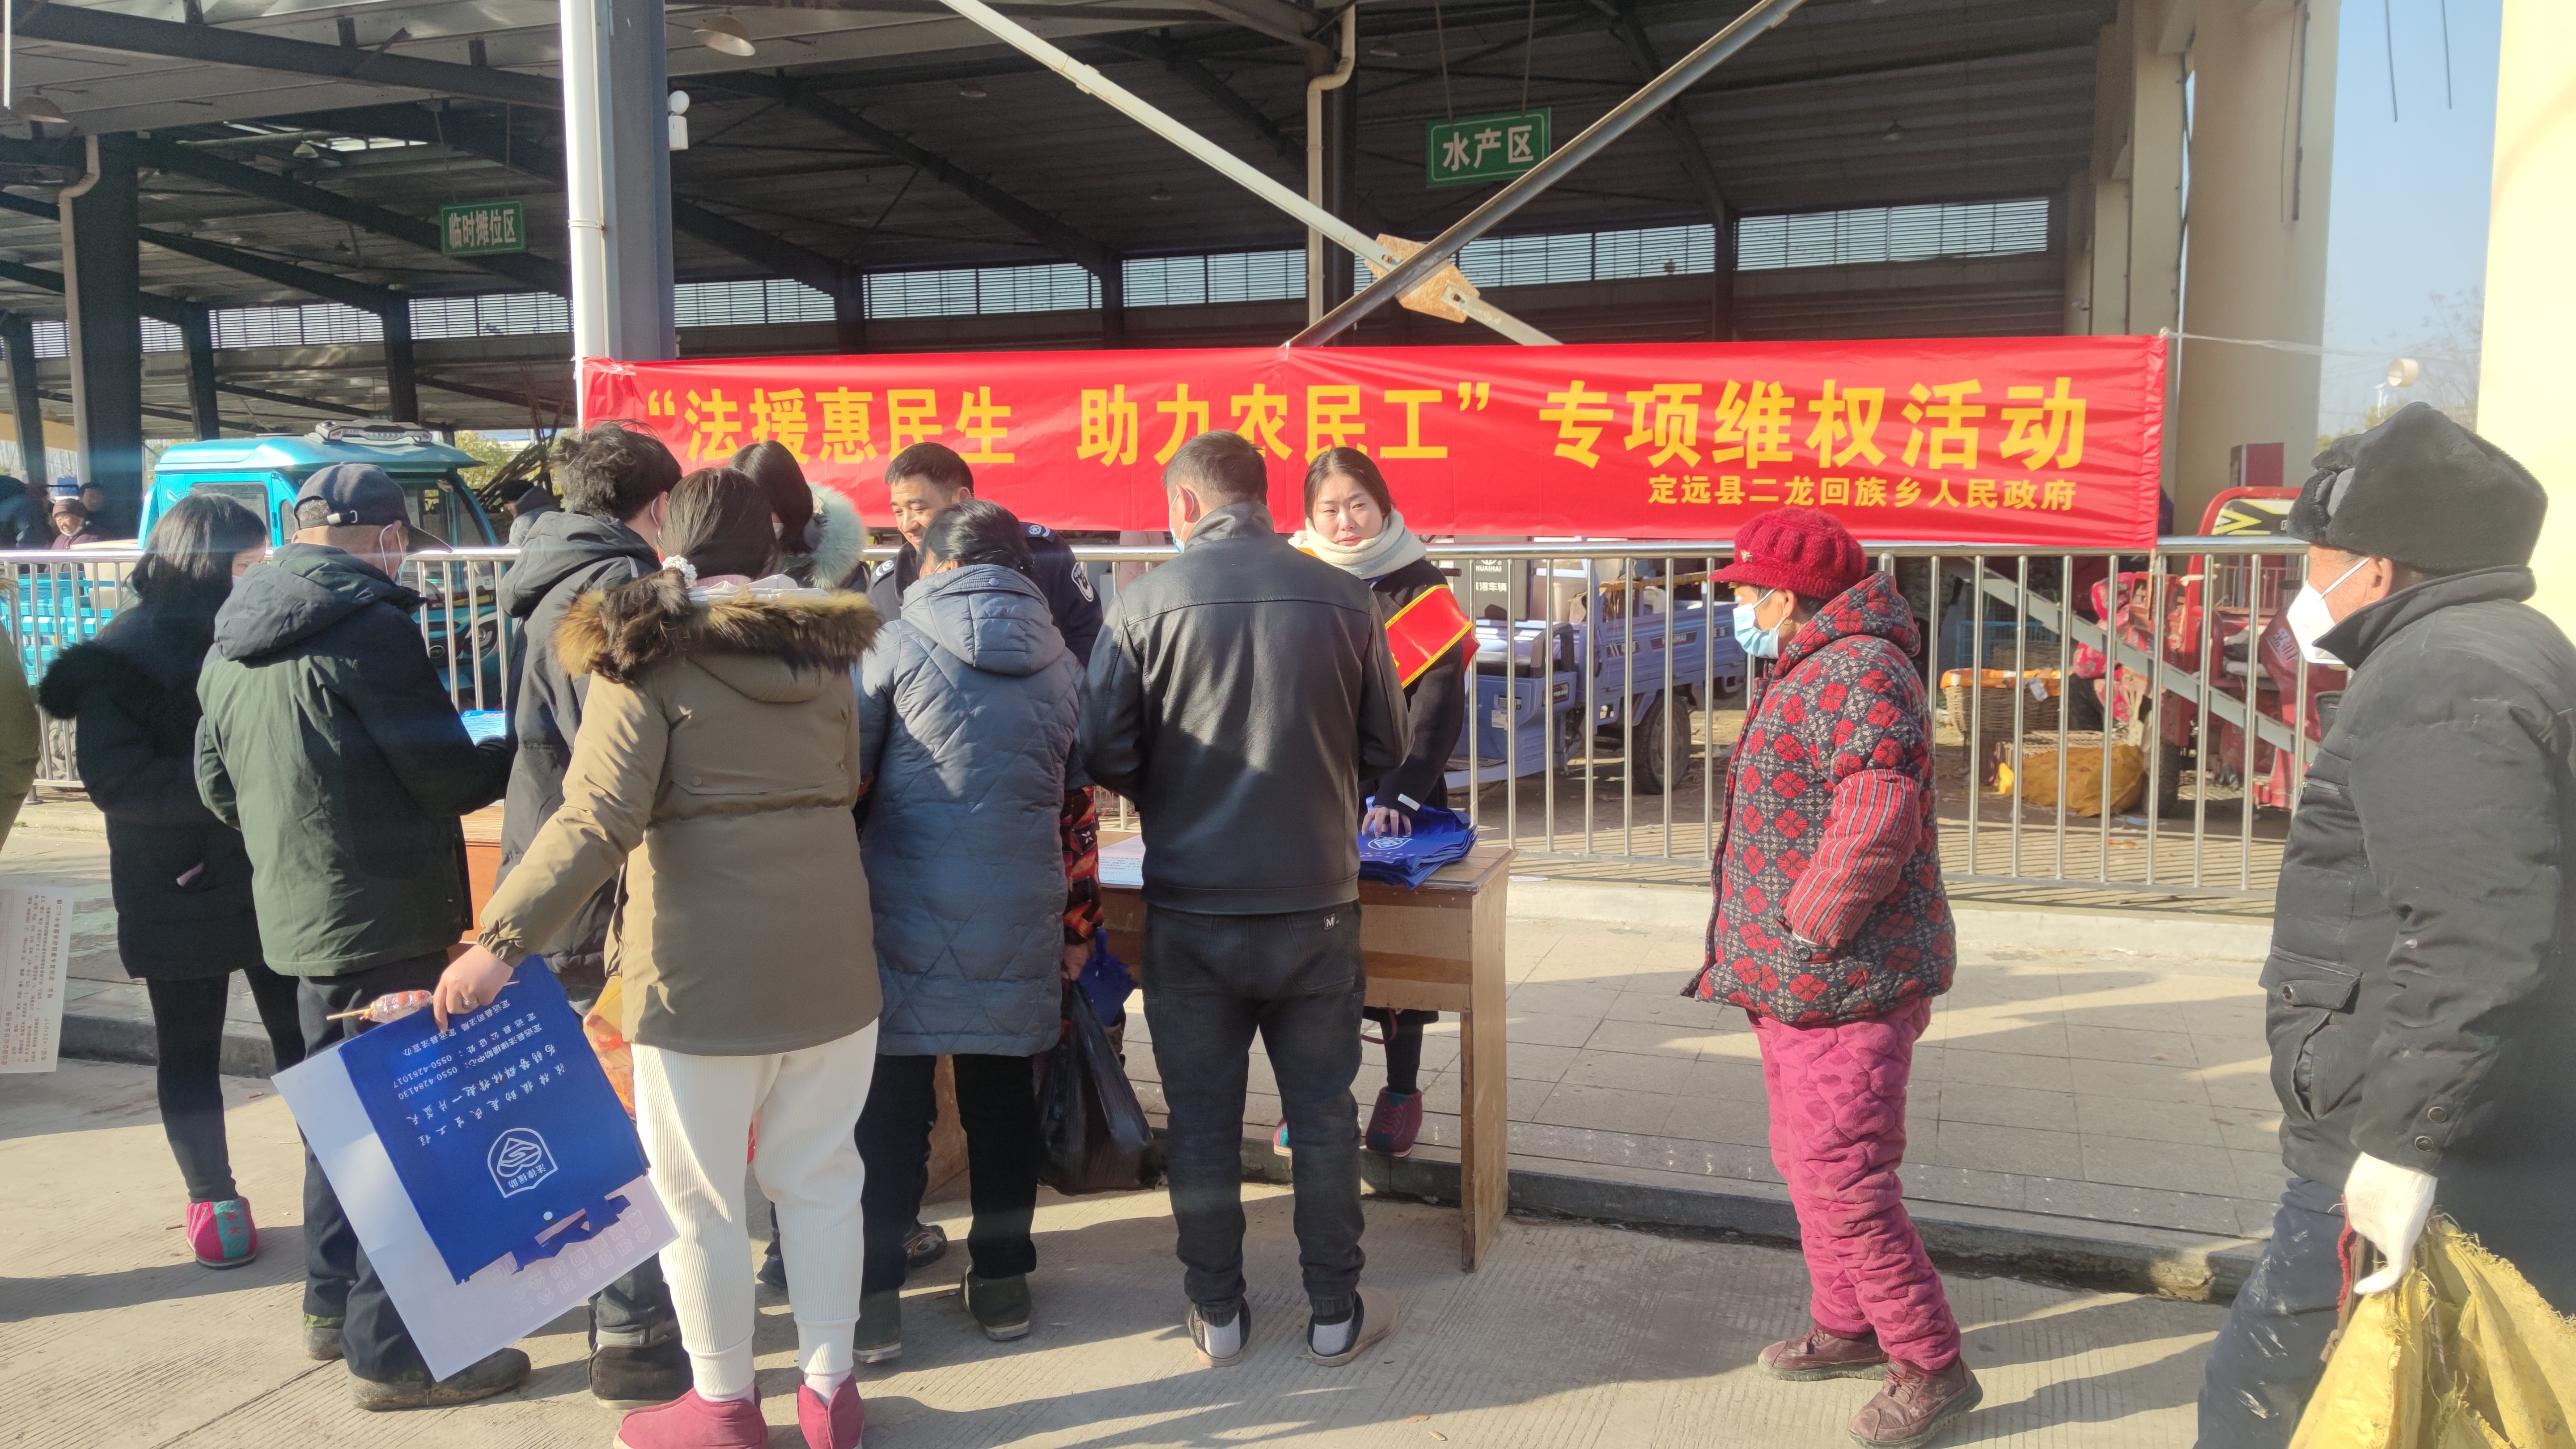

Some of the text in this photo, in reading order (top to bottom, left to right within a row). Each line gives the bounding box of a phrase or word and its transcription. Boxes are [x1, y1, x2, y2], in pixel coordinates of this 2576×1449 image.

[1442, 125, 1534, 171] 水产区
[449, 209, 516, 249] 临时摊位区
[648, 377, 2086, 470] “法援惠民生 助力农民工” 专项维权活动
[1649, 474, 2076, 511] 定远县二龙回族乡人民政府
[461, 999, 510, 1031] 定远县司法局
[406, 1044, 555, 1126] 为弱势群体撑起一片蓝天
[418, 1063, 565, 1146] 法律援助是民生工程
[508, 1163, 546, 1189] 法律援助
